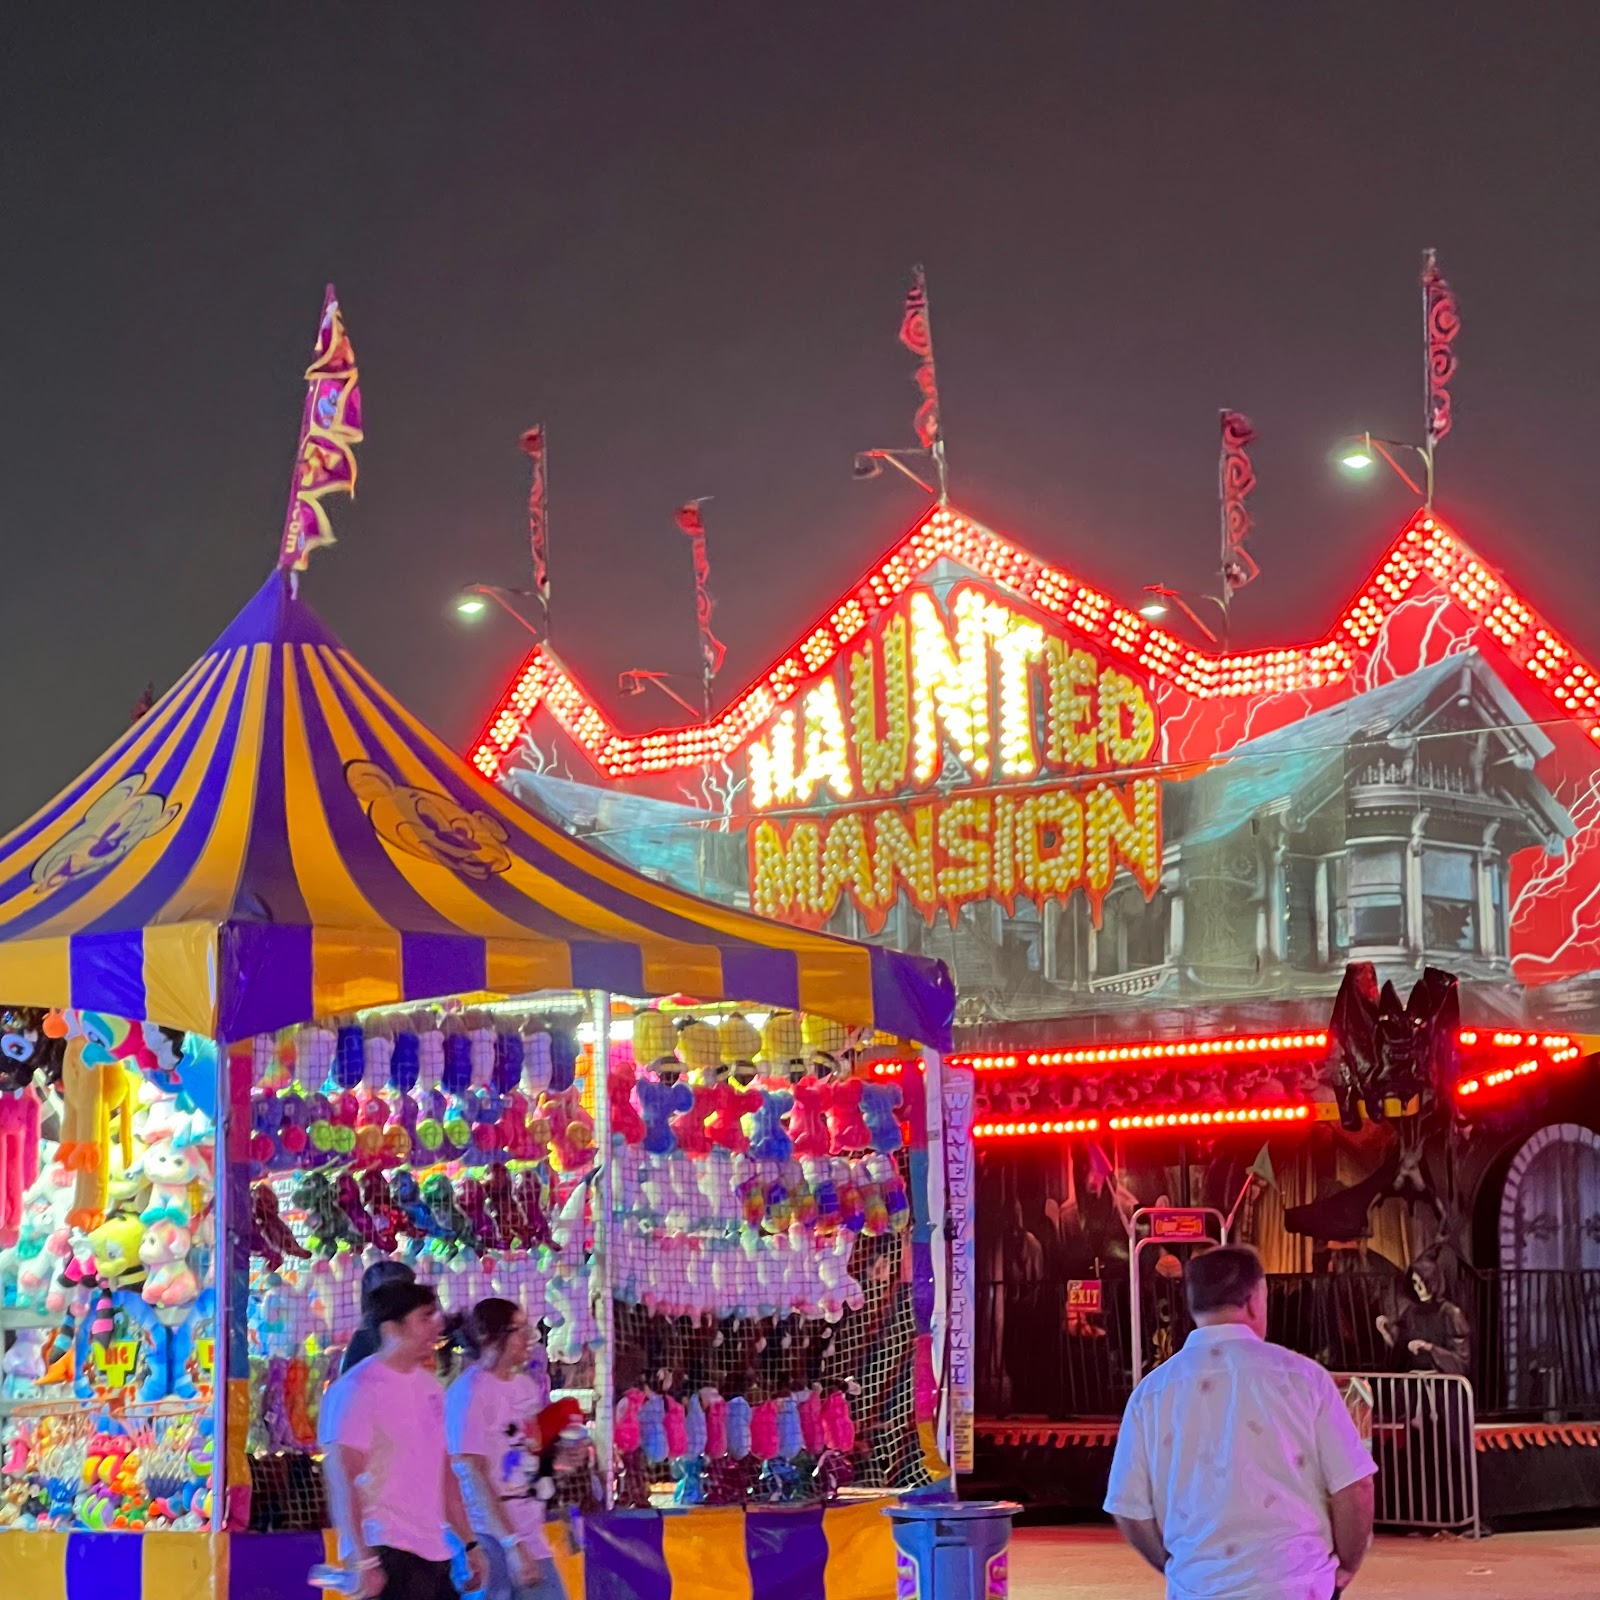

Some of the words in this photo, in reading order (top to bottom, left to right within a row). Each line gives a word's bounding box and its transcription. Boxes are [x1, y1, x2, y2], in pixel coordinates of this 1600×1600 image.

[748, 588, 1155, 810] HAUNTED
[752, 778, 1158, 917] MANSION
[944, 1092, 970, 1198] WINNER
[1068, 1289, 1099, 1304] EXIT
